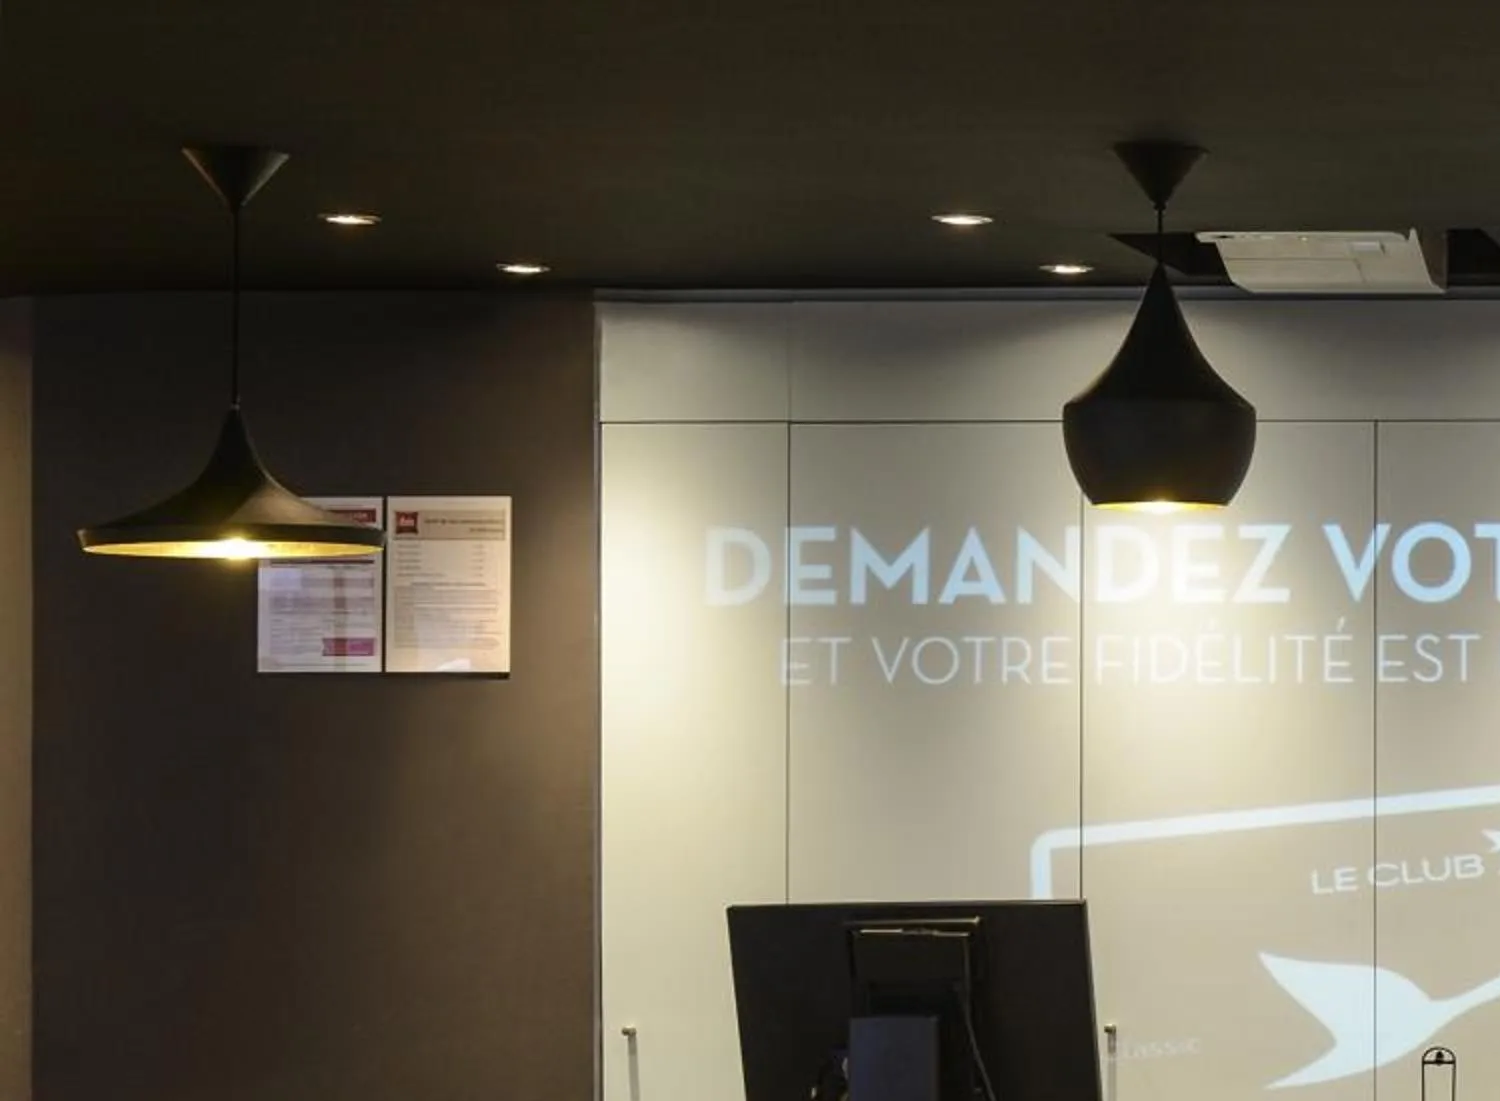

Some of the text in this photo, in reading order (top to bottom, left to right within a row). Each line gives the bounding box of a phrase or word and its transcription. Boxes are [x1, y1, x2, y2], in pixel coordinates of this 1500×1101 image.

[703, 523, 1291, 606] DEMANDEZ
[780, 636, 852, 686] ET
[873, 635, 1072, 685] VOTRE
[1095, 616, 1354, 684] FIDÉLITÉ
[1379, 633, 1482, 682] EST
[1310, 866, 1359, 894] LE
[1367, 854, 1485, 887] CLUB
